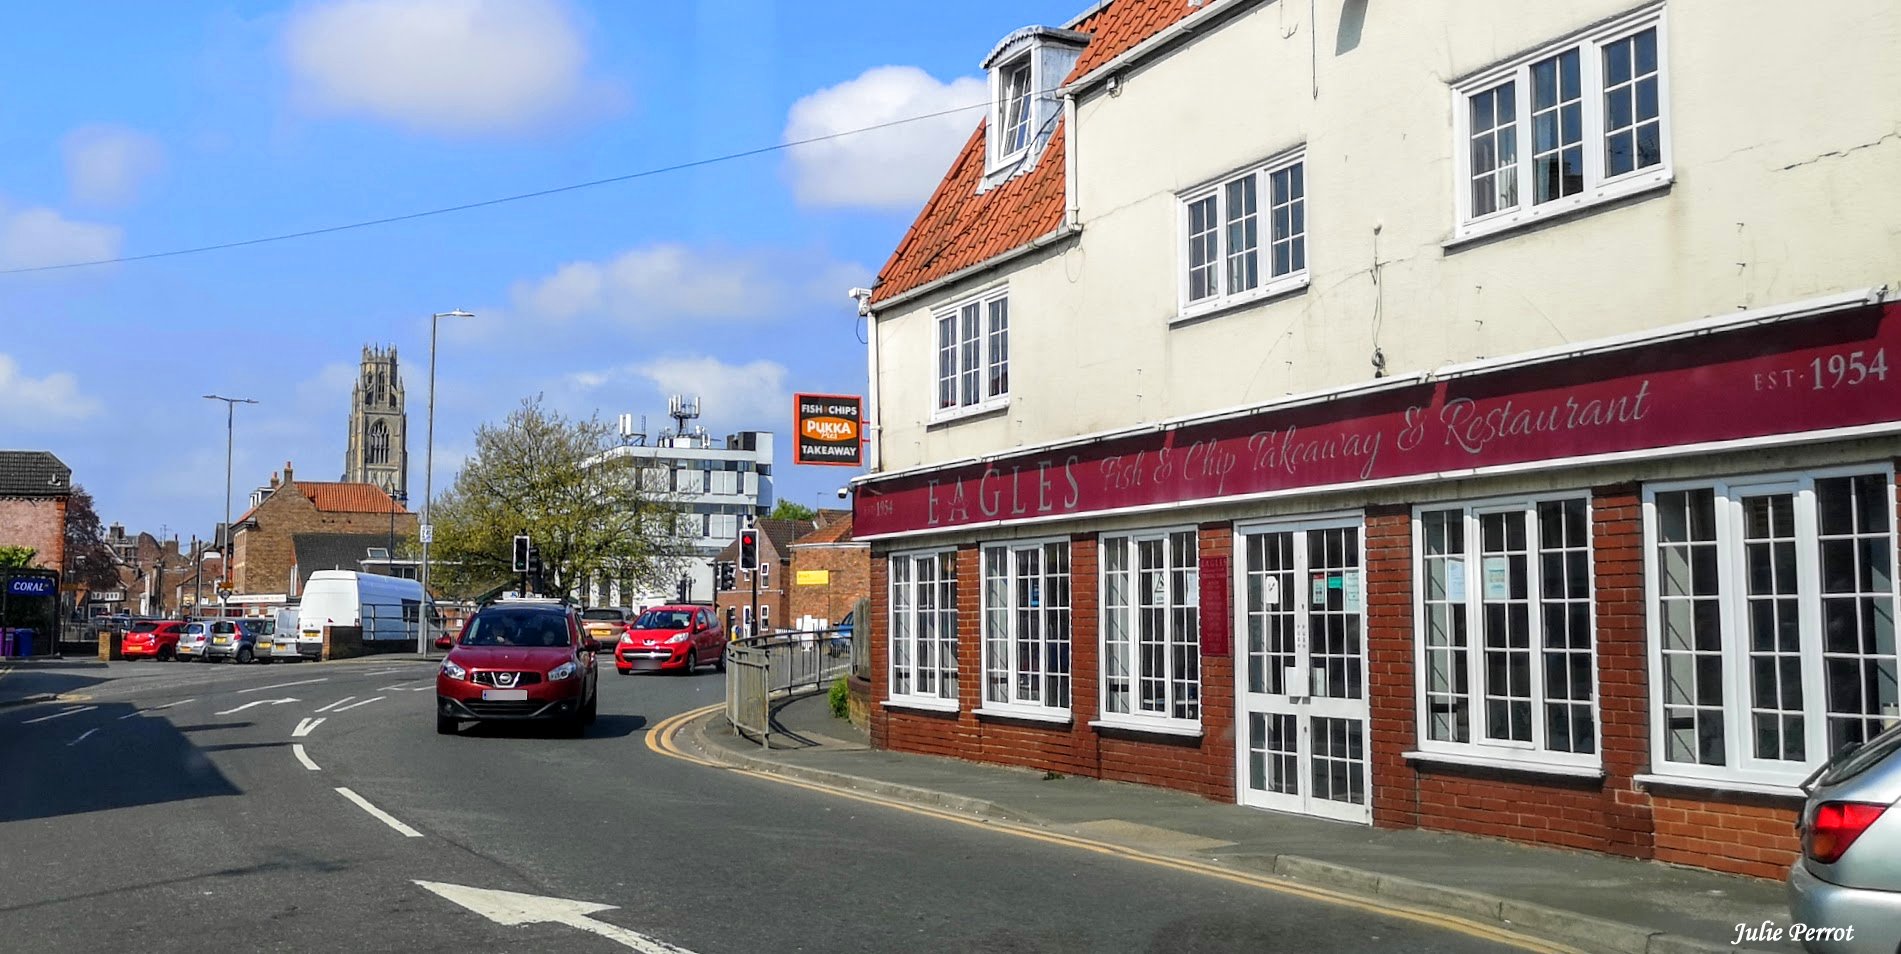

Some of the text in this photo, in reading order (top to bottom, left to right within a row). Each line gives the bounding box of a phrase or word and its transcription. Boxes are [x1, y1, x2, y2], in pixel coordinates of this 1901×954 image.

[1809, 346, 1889, 391] 1954
[801, 404, 823, 414] FISH
[828, 405, 858, 416] CHIPS
[806, 420, 852, 435] PUKKA
[801, 445, 857, 457] TAKEAWAY
[927, 379, 1652, 526] EAGLES Fish & Chip Takeaway & Restaurant
[876, 499, 894, 517] 1954
[13, 581, 44, 592] CORAL
